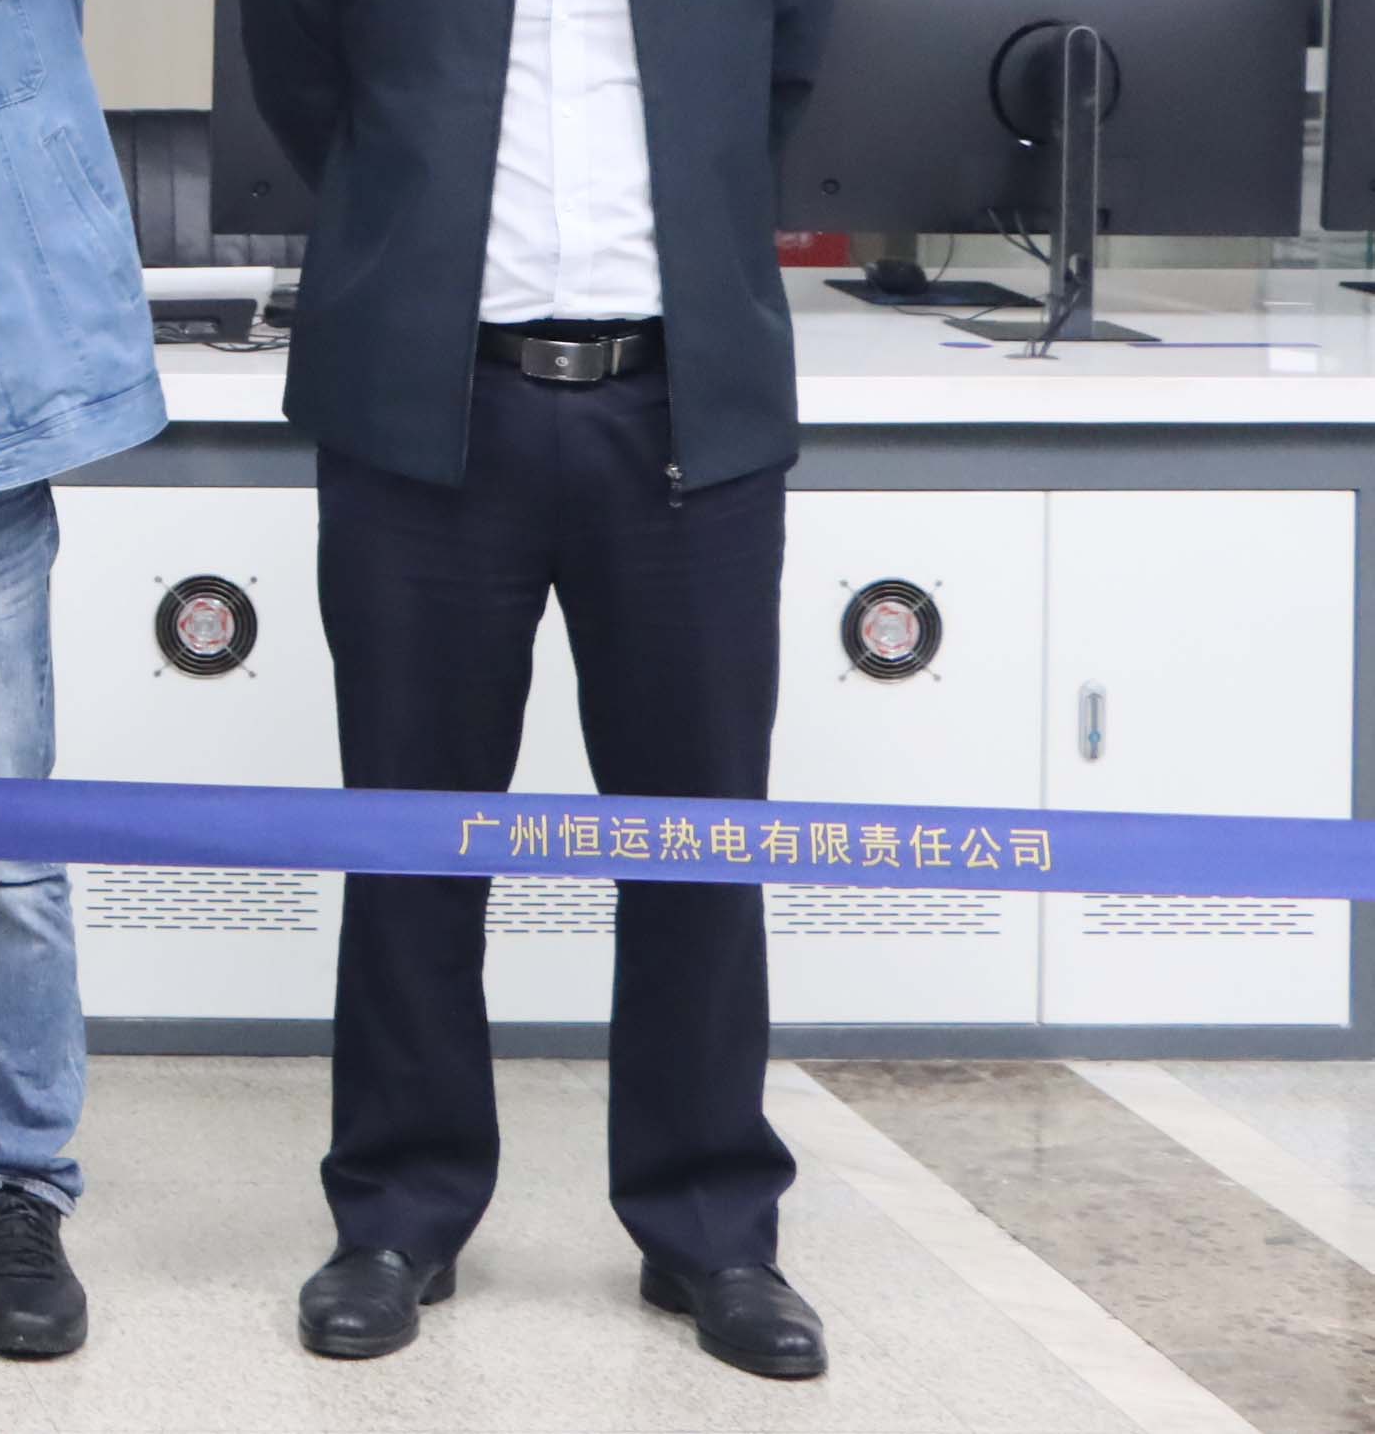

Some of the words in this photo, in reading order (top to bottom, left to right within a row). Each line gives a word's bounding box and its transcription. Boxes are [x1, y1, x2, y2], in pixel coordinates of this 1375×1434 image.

[458, 811, 1052, 872] 广州恒运热电有限责任公司
